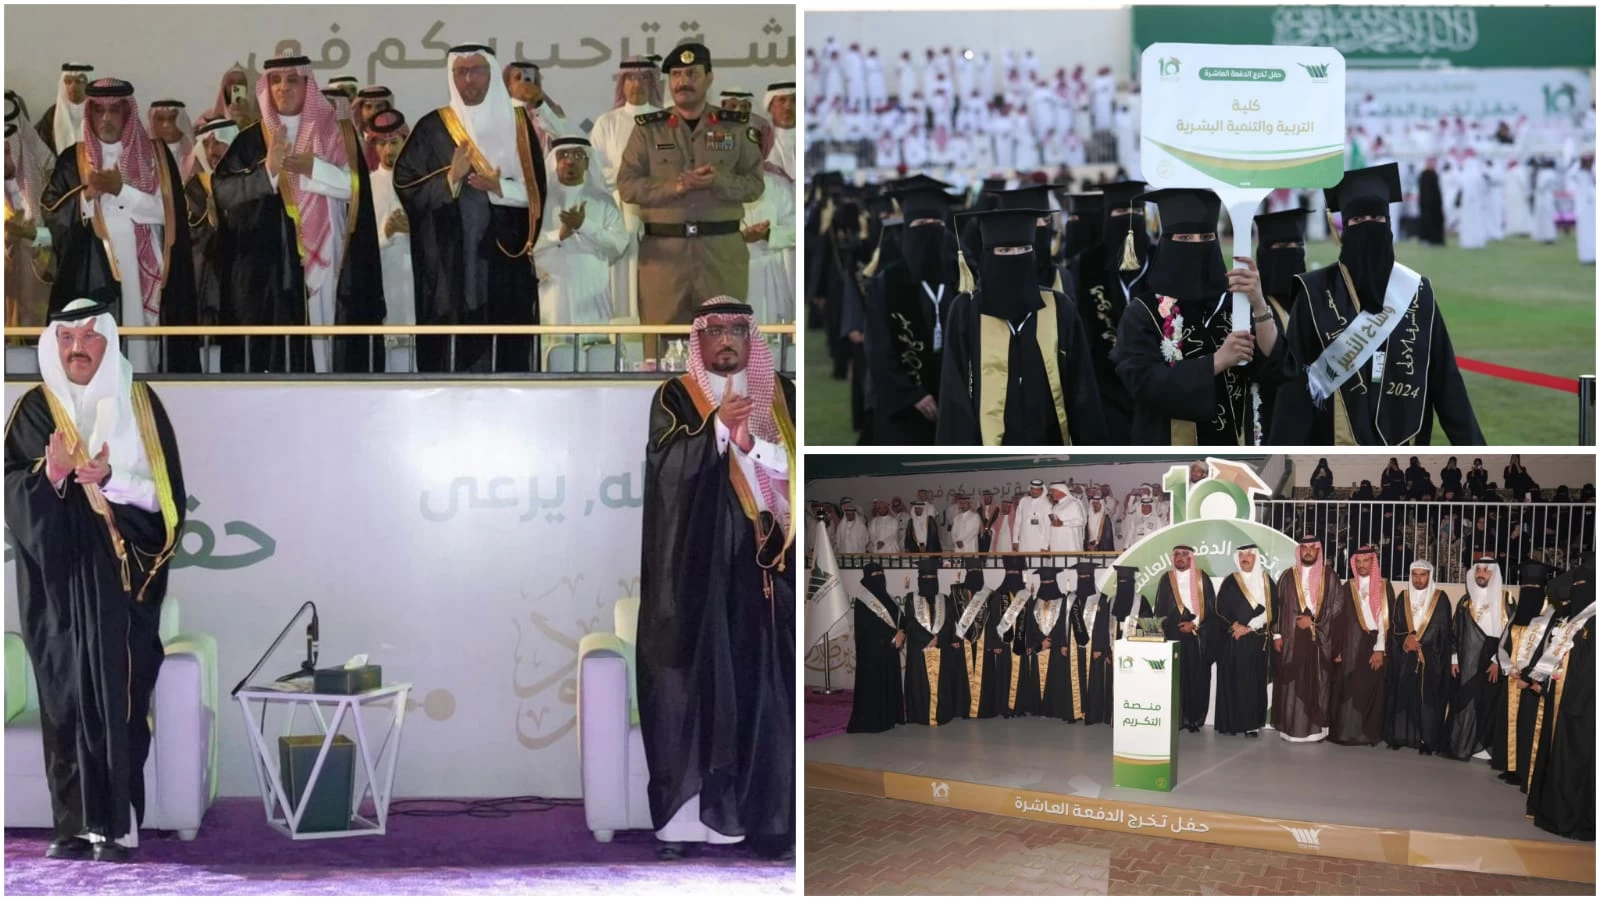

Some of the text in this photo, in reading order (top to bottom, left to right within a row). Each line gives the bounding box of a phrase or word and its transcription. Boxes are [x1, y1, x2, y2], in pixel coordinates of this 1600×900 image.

[367, 20, 497, 86] كم
[1204, 69, 1282, 80] حفل تخرج الدفعة العاشرة
[1232, 98, 1261, 116] كلية
[1176, 118, 1314, 136] التربية والتنمية البشرية
[1386, 382, 1420, 399] 2024
[419, 474, 567, 523] يرعى
[1163, 465, 1255, 522] 10
[169, 494, 277, 571] حف
[1135, 552, 1173, 594] العاش
[1123, 700, 1162, 711] منصة
[1122, 716, 1161, 727] التكريم
[1014, 797, 1210, 834] حفل تخرج الدفعة العاشرة
